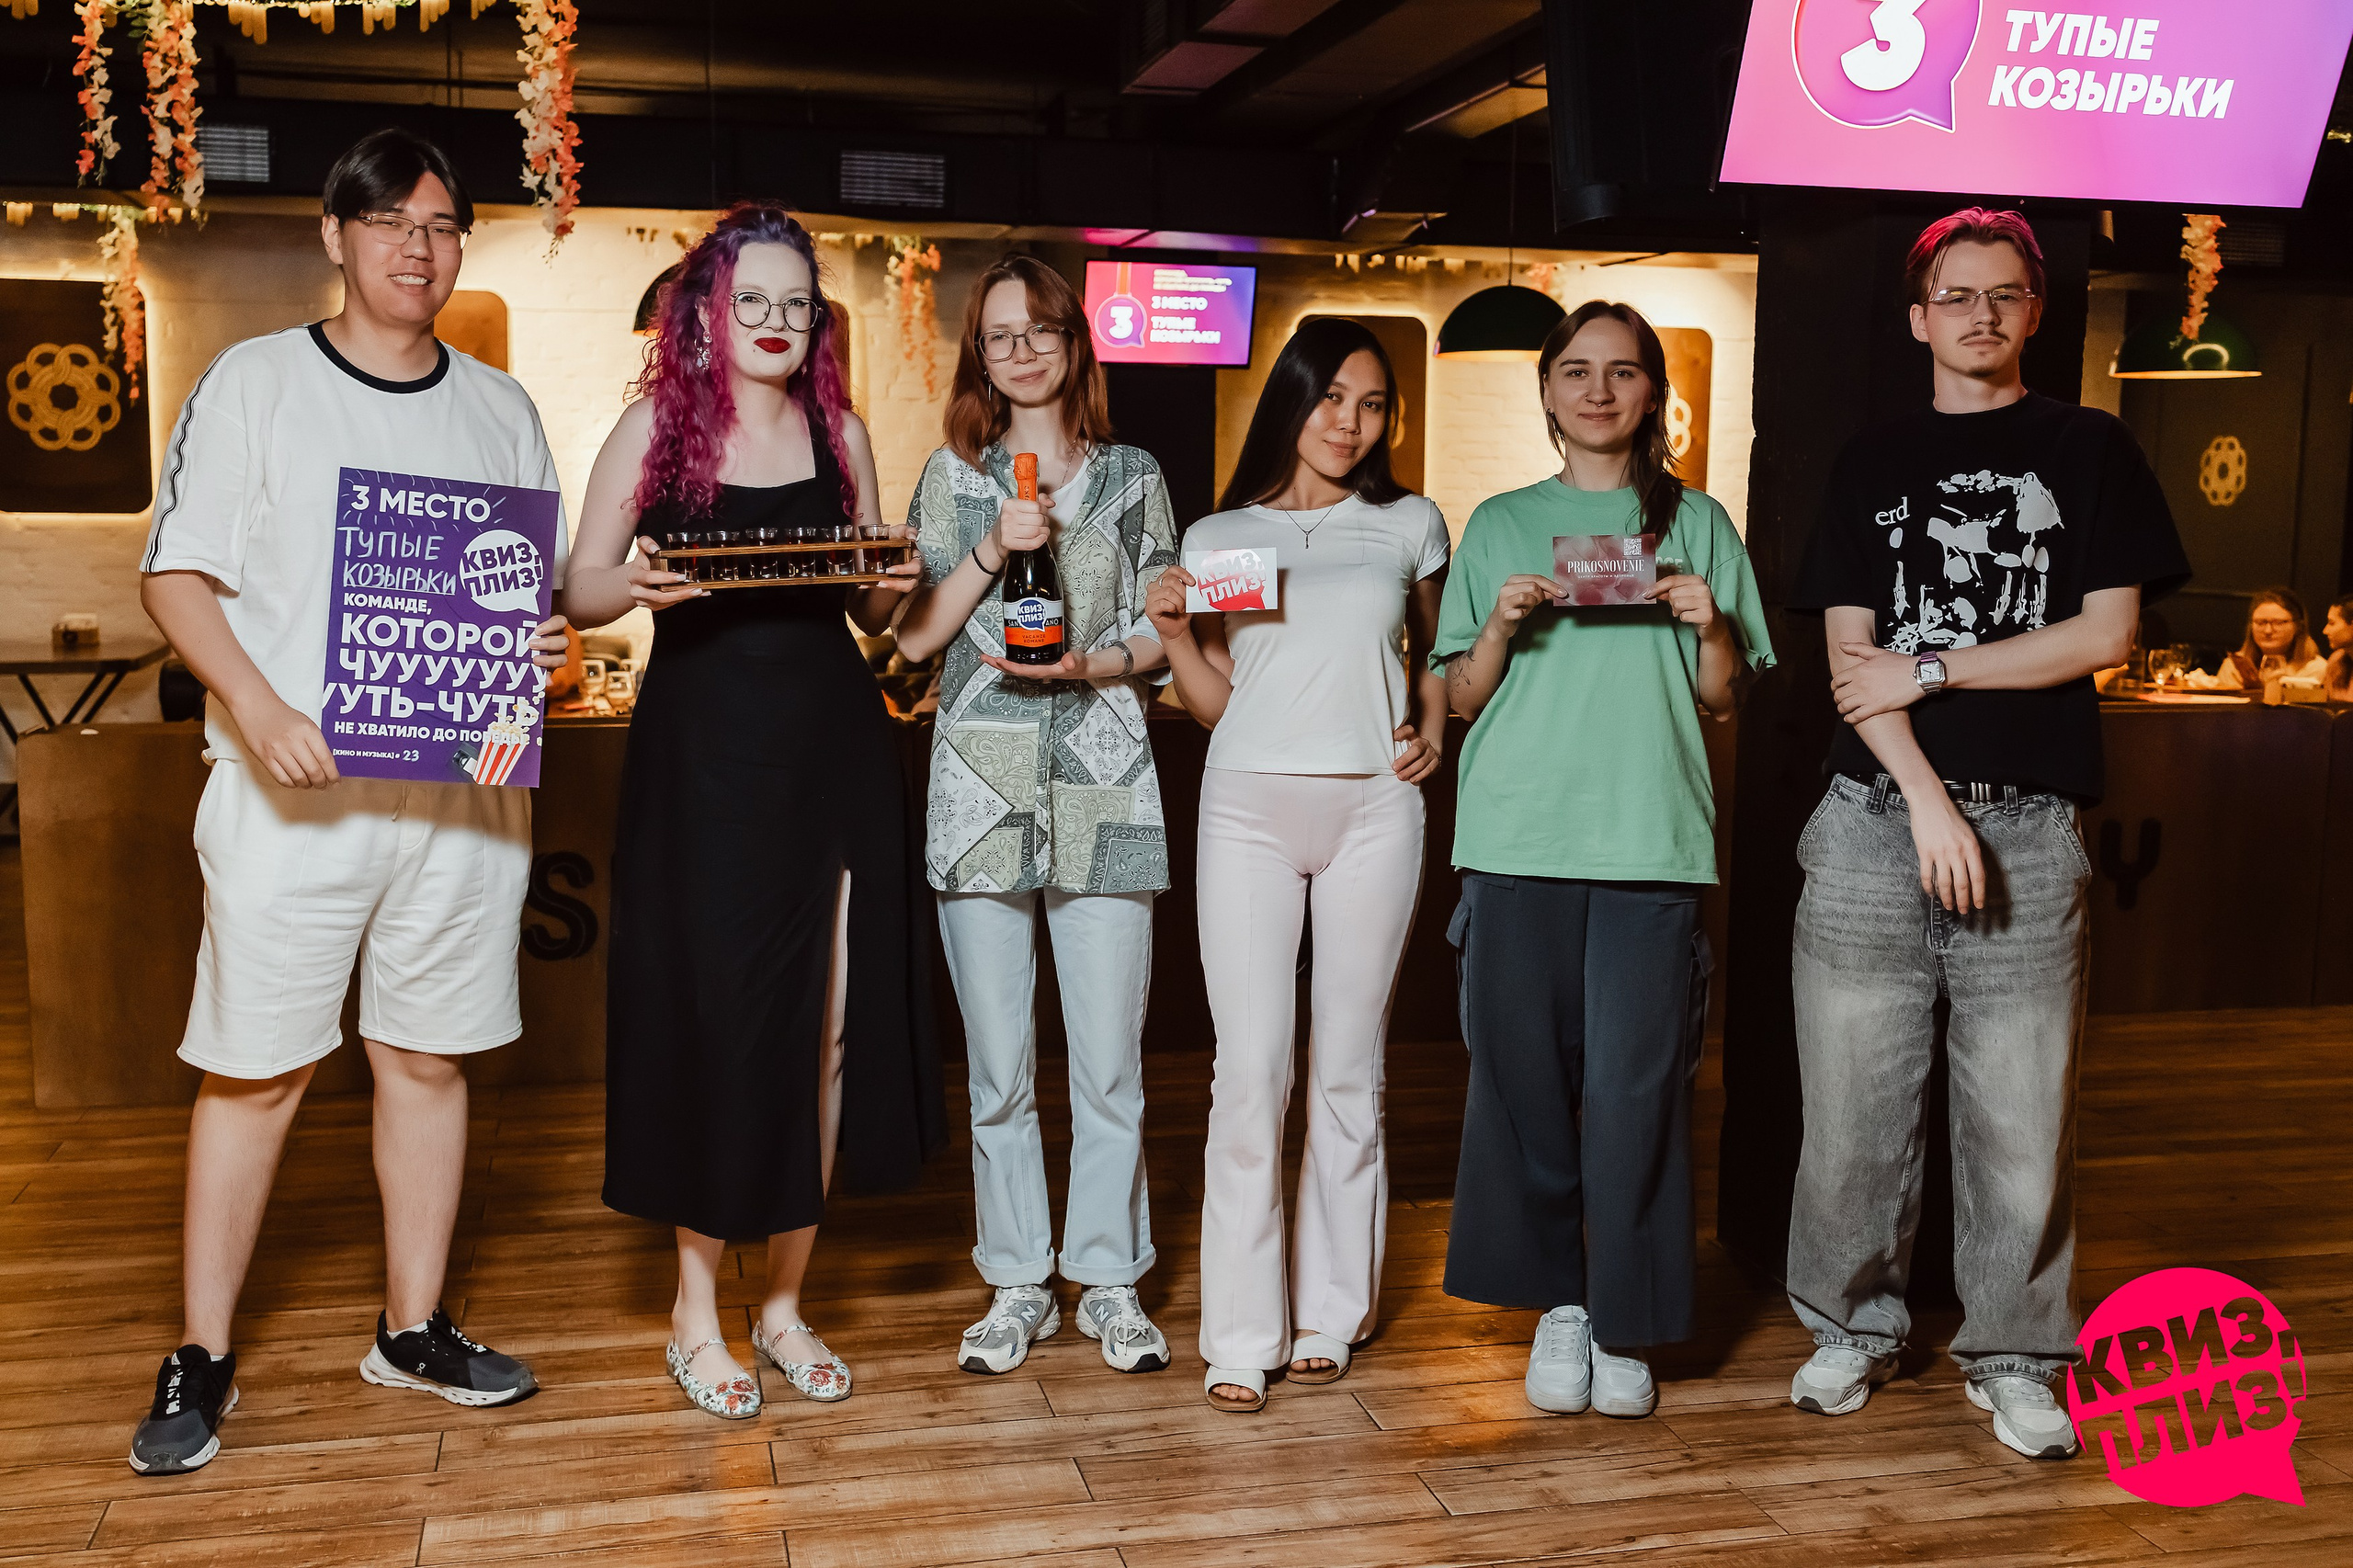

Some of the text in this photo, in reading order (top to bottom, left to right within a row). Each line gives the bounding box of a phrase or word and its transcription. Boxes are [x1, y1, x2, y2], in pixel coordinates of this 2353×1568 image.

[1840, 0, 1927, 91] 3
[2005, 9, 2160, 61] ТУПЫЕ
[1987, 64, 2234, 119] КОЗЫРЬКИ
[1108, 306, 1133, 339] 3
[351, 484, 491, 523] 3 МЕСТО
[1875, 496, 1910, 526] erd
[336, 526, 445, 561] ТУПЫЕ
[343, 560, 457, 596] КОЗЫРЬКИ
[1567, 559, 1644, 573] PRIKOSNOVENIE
[344, 593, 432, 616] КОМАНДЕ,
[341, 612, 540, 659] КОТОРОЙ
[334, 721, 355, 734] НЕ
[357, 722, 430, 740] ХВАТИЛО
[432, 729, 458, 743] ДО
[402, 749, 420, 762] 23
